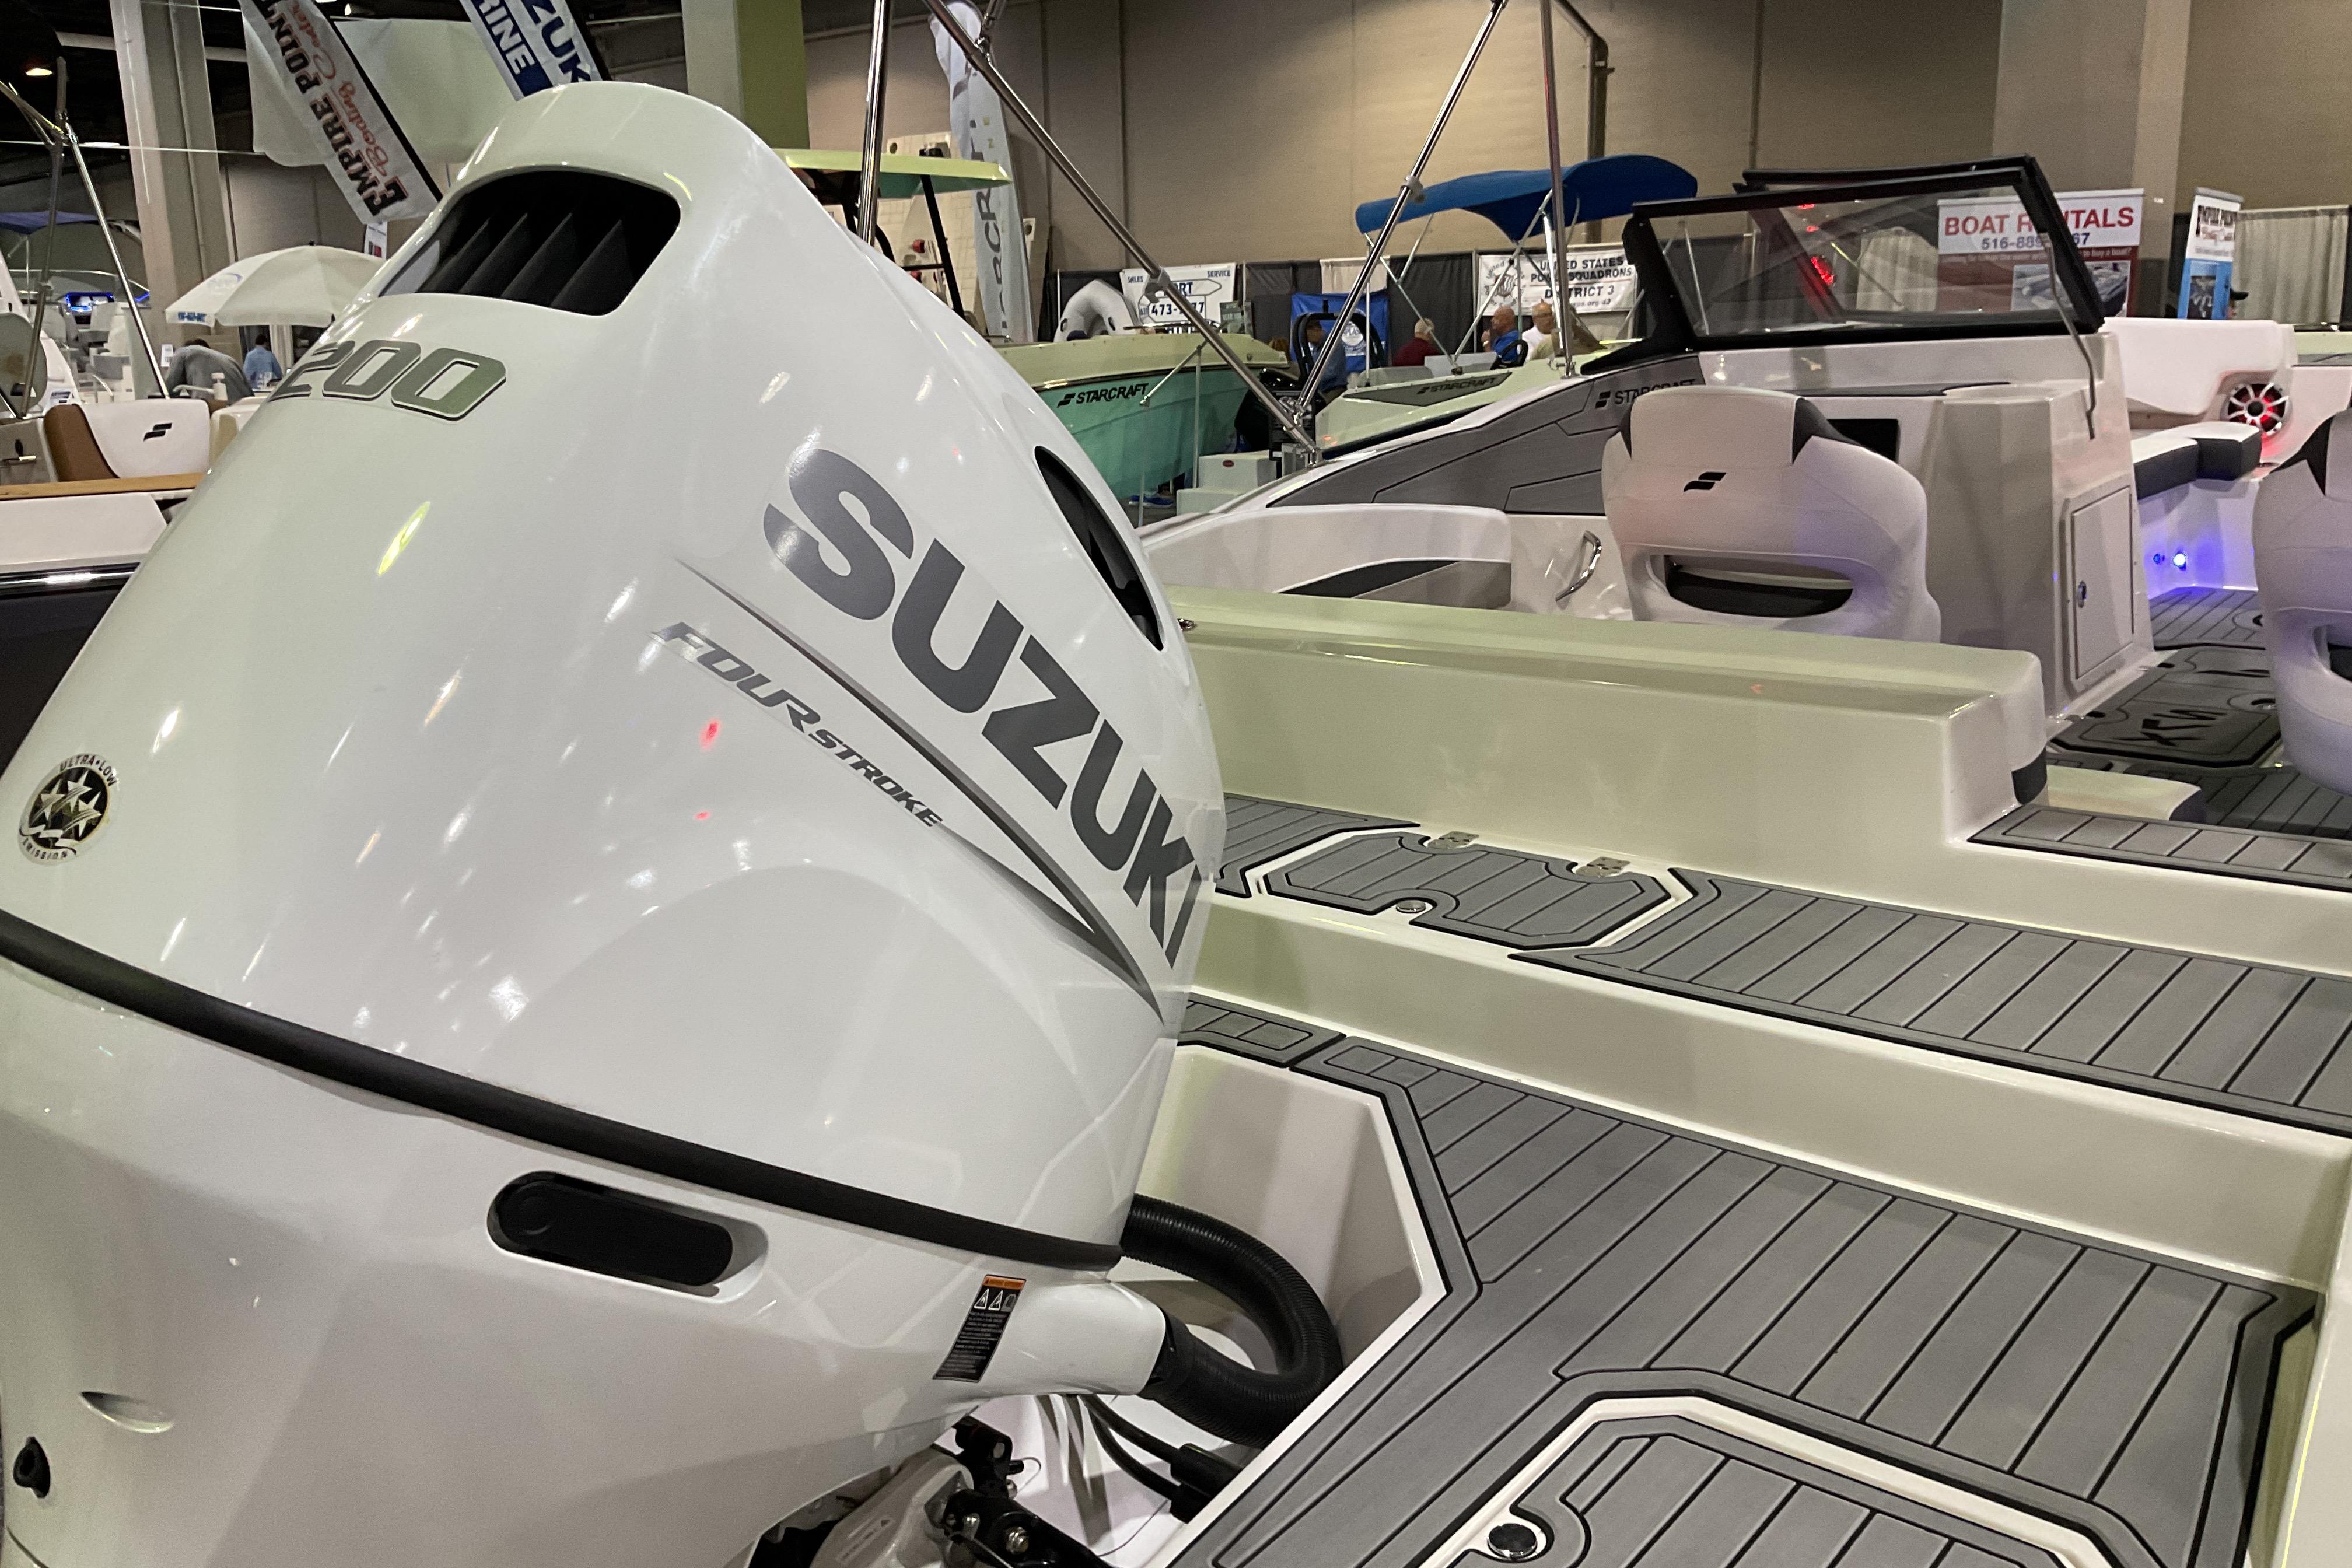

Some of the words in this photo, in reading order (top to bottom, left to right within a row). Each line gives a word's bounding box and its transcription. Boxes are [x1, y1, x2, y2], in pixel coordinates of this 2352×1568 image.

[309, 93, 408, 216] EMPIRE
[1945, 214, 2011, 236] BOAT
[2017, 206, 2134, 233] RTALS
[1582, 256, 1623, 269] STATES
[1128, 275, 1143, 284] SALES
[1569, 268, 1632, 281] SQUADRONS
[1545, 285, 1604, 299] DTRICT
[1607, 285, 1615, 296] 3
[269, 340, 506, 422] 200
[1430, 376, 1498, 393] STARCRAFT
[1076, 383, 1149, 404] STARCRAFT
[763, 449, 1203, 969] SUZUKI
